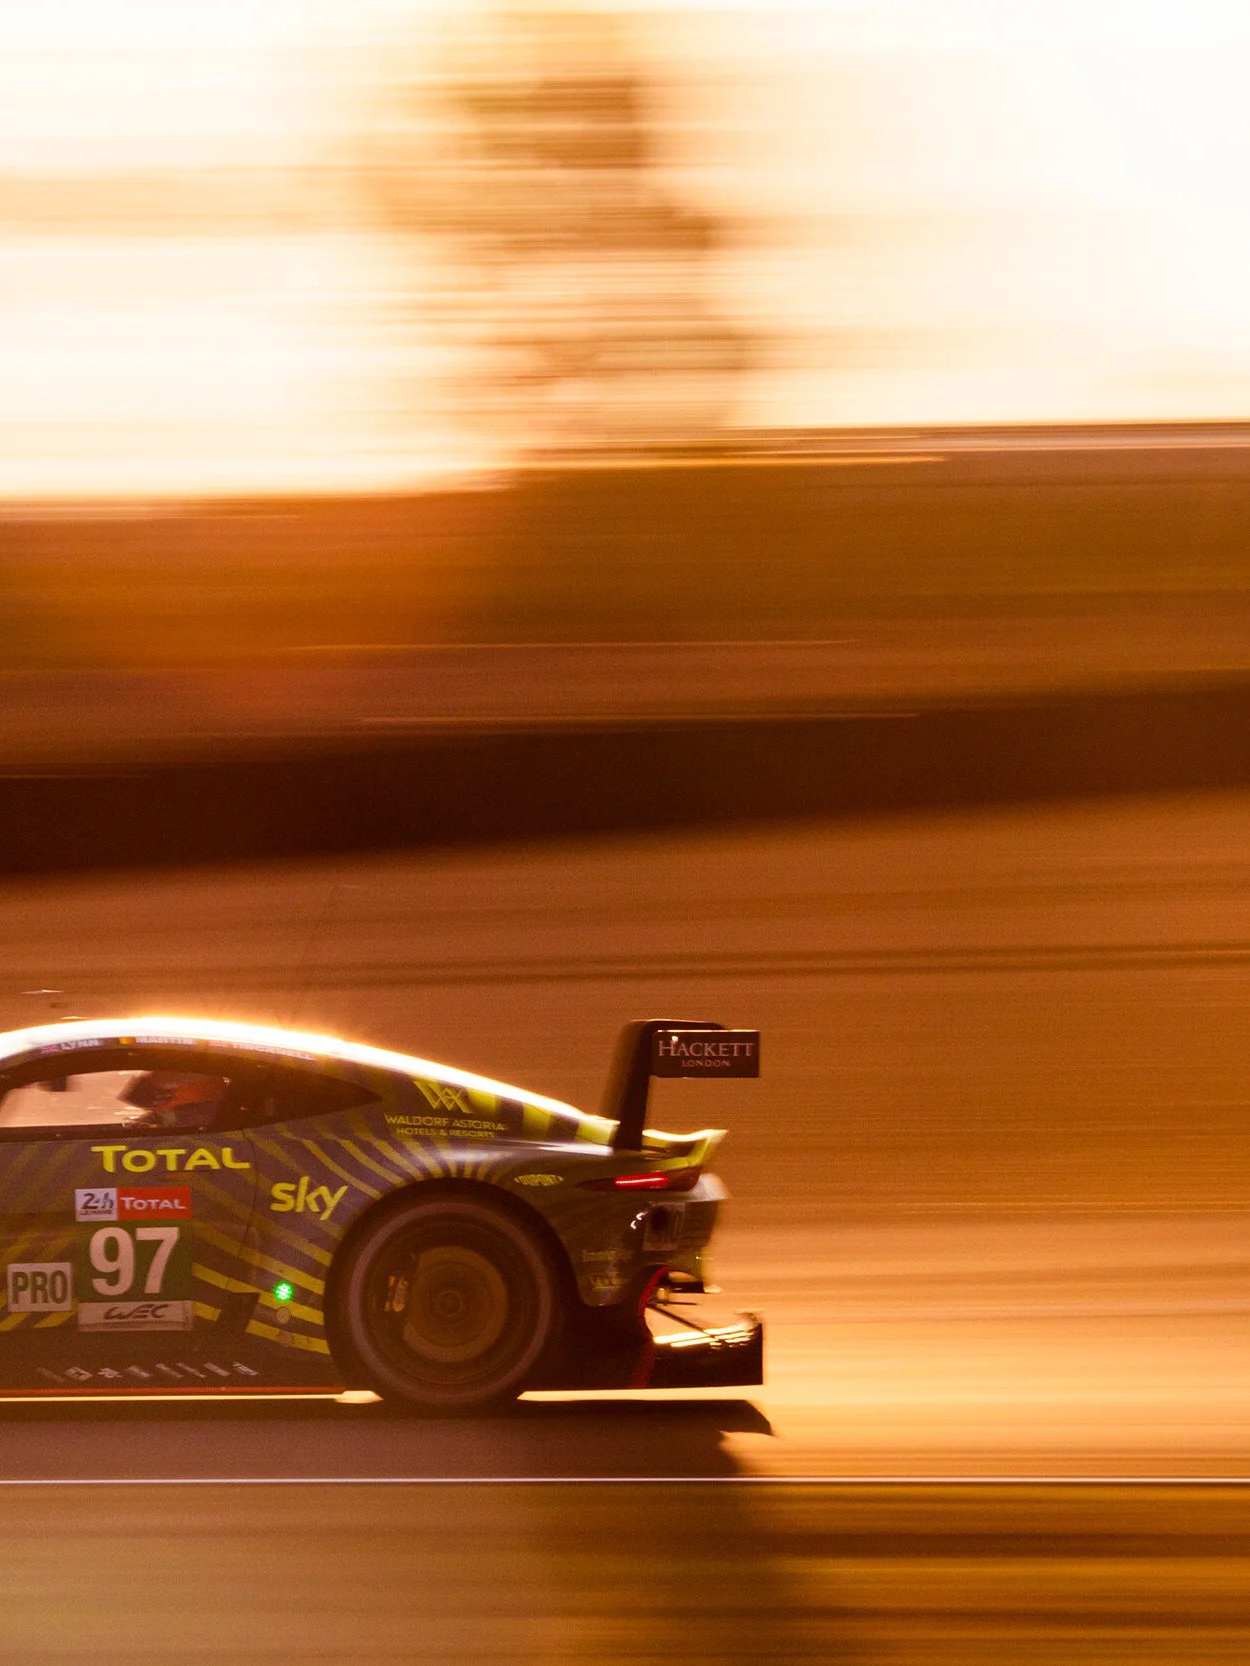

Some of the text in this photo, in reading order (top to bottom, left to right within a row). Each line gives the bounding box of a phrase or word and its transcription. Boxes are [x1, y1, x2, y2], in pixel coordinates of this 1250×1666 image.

[60, 1039, 99, 1050] LYNN
[657, 1040, 754, 1057] HACKETT
[681, 1060, 731, 1068] LONDON
[384, 1112, 505, 1131] WALDORF ASTORIA
[396, 1127, 495, 1138] HOTELS & RESORTS
[91, 1145, 250, 1173] TOTAL
[120, 1196, 187, 1211] TOTAL
[270, 1176, 349, 1220] sky
[89, 1226, 180, 1296] 97
[12, 1270, 68, 1305] PRO
[102, 1303, 169, 1320] WEC
